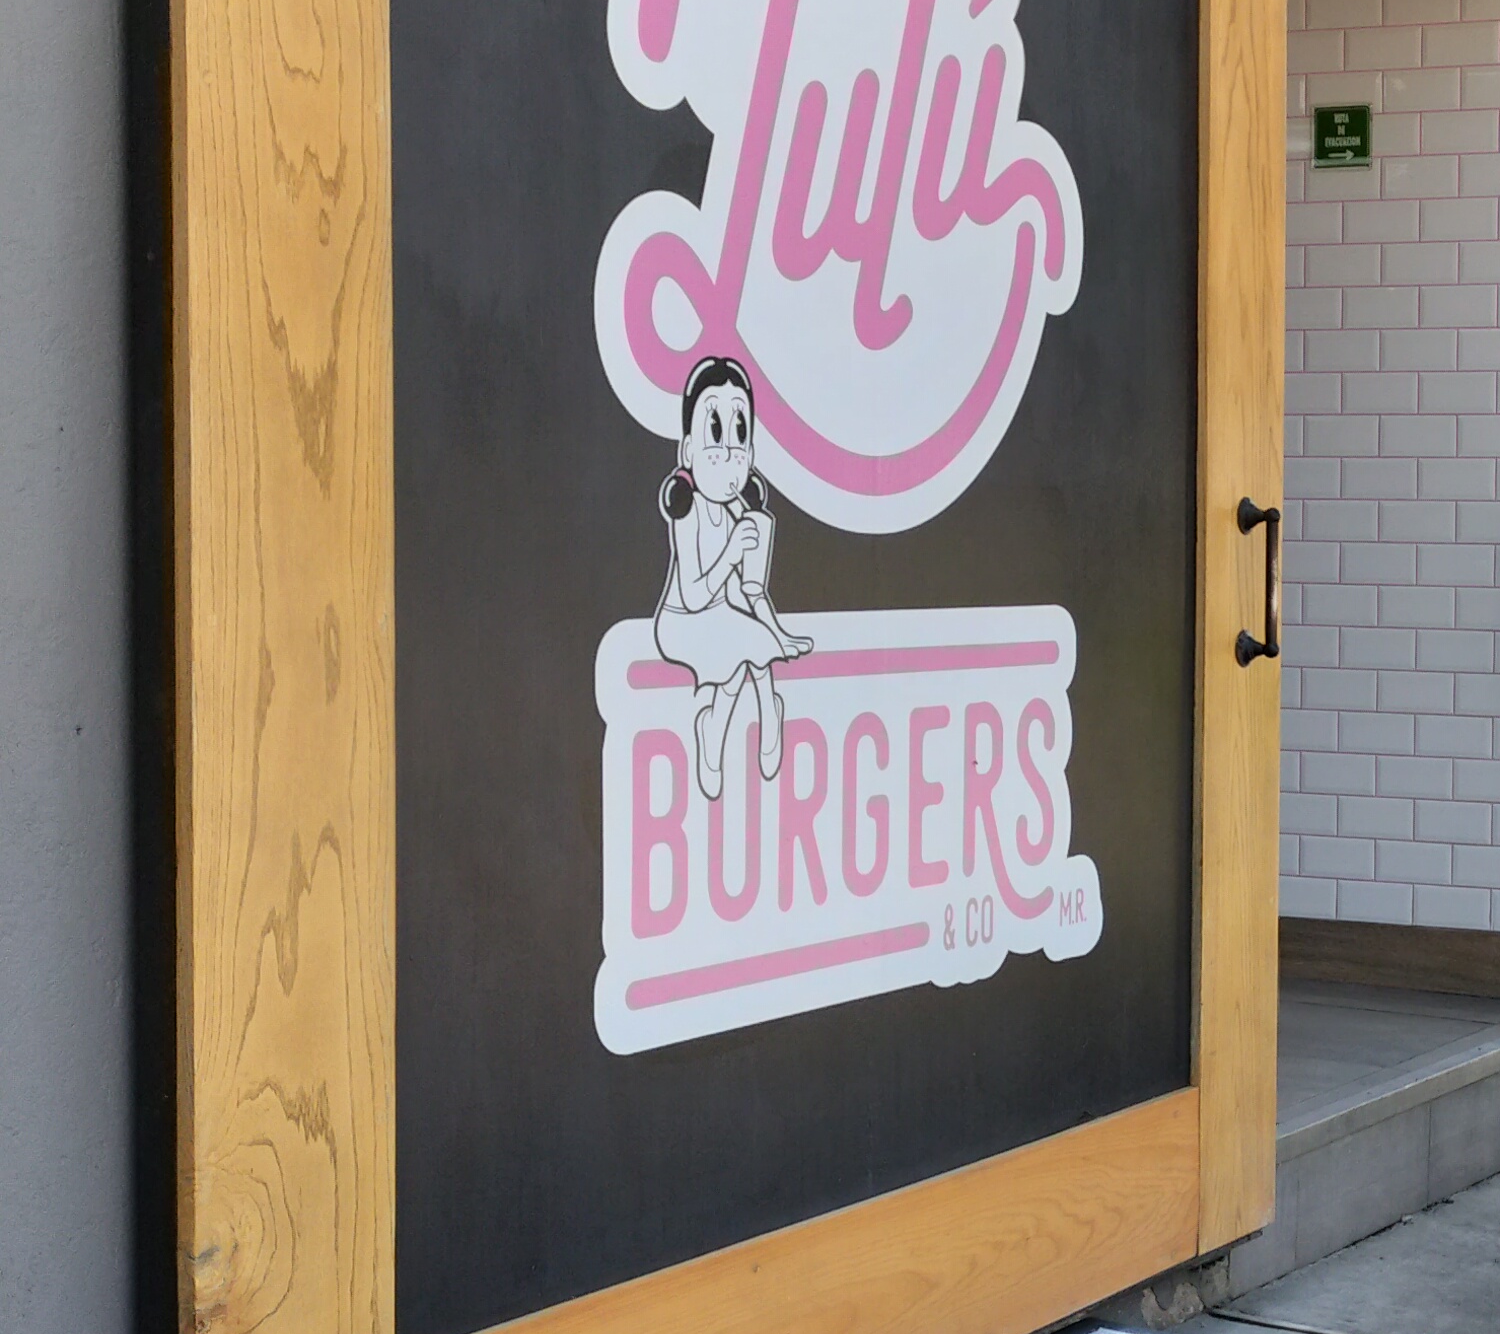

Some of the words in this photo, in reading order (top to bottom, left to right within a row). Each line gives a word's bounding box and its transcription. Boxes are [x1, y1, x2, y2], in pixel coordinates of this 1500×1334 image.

[631, 698, 1056, 940] BURGERS
[943, 903, 956, 951] &
[965, 894, 994, 948] CO
